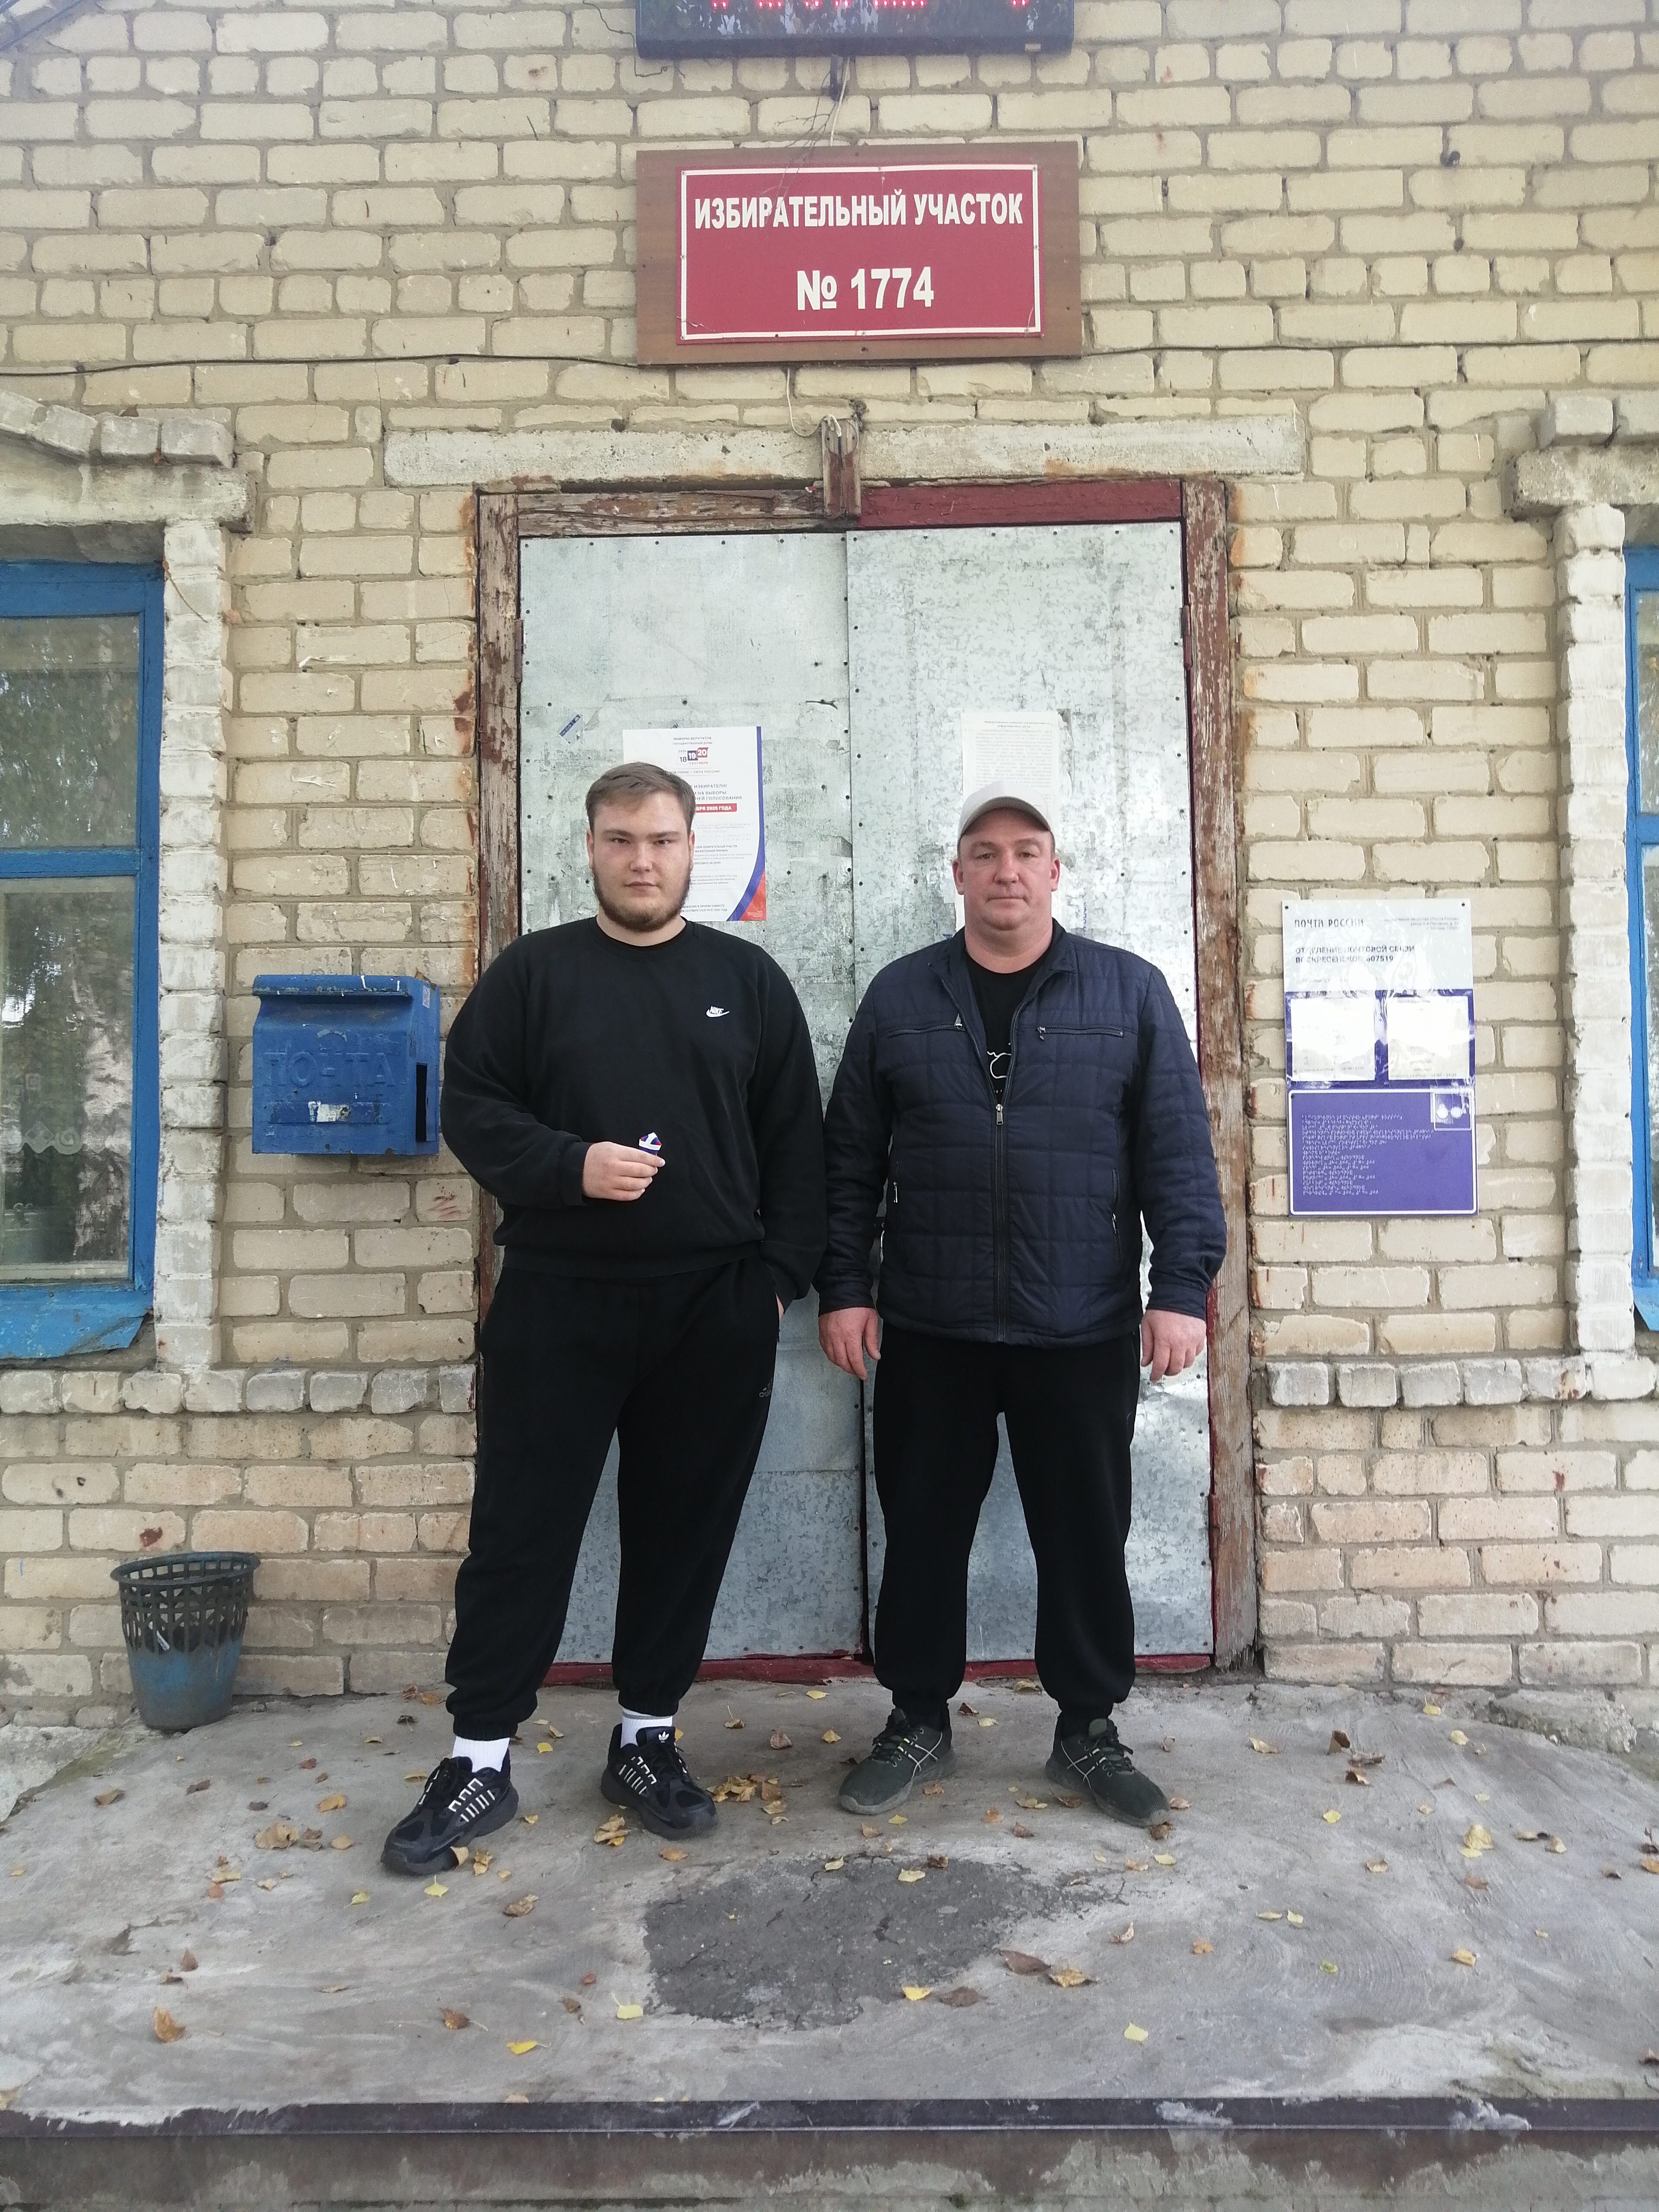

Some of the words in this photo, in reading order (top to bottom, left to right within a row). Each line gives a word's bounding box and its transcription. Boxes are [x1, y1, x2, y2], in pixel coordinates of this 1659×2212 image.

[695, 188, 906, 229] ИЗБИРАТЕЛЬНЫЙ
[913, 193, 1023, 225] УЧАСТОК
[797, 270, 837, 311] №
[851, 267, 934, 309] 1774
[1294, 919, 1324, 928] ПОЧТА
[1328, 918, 1363, 927] РОССИИ
[709, 1006, 724, 1015] NIKE
